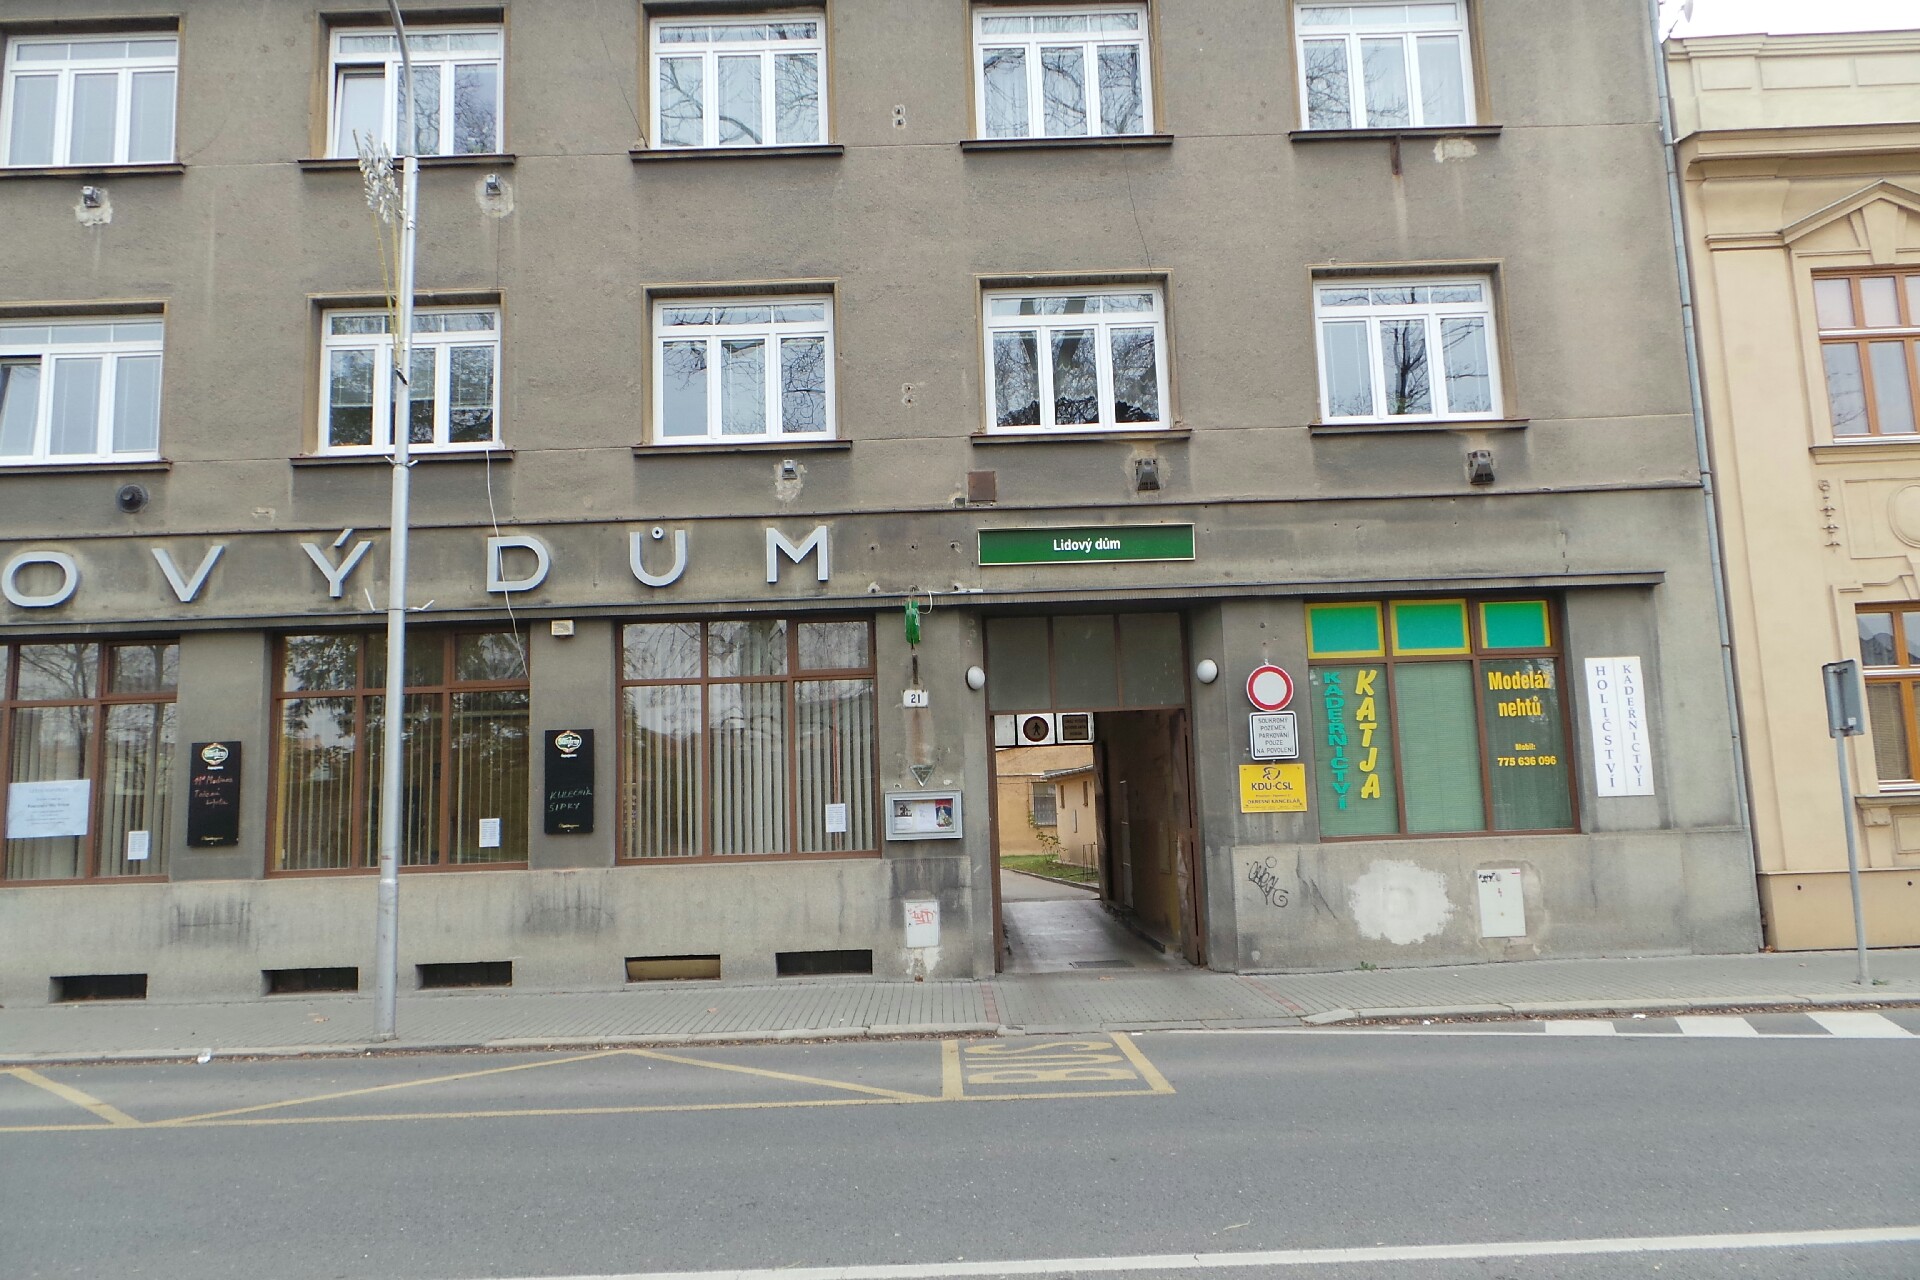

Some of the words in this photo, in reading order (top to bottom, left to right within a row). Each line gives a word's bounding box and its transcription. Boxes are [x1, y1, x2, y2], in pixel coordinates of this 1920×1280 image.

[486, 525, 829, 594] DŮM
[1053, 538, 1092, 553] Lidový
[1095, 537, 1121, 550] dům
[911, 694, 921, 703] 21
[1498, 695, 1543, 717] nehtů
[1355, 669, 1381, 799] KATJA
[1595, 665, 1616, 788] HOLIČSTVÍ
[1623, 664, 1643, 787] KADEŘNICTVÍ
[1498, 757, 1516, 767] 775
[1517, 756, 1537, 766] 636
[1538, 755, 1557, 766] 096
[964, 1041, 1138, 1085] BUS
